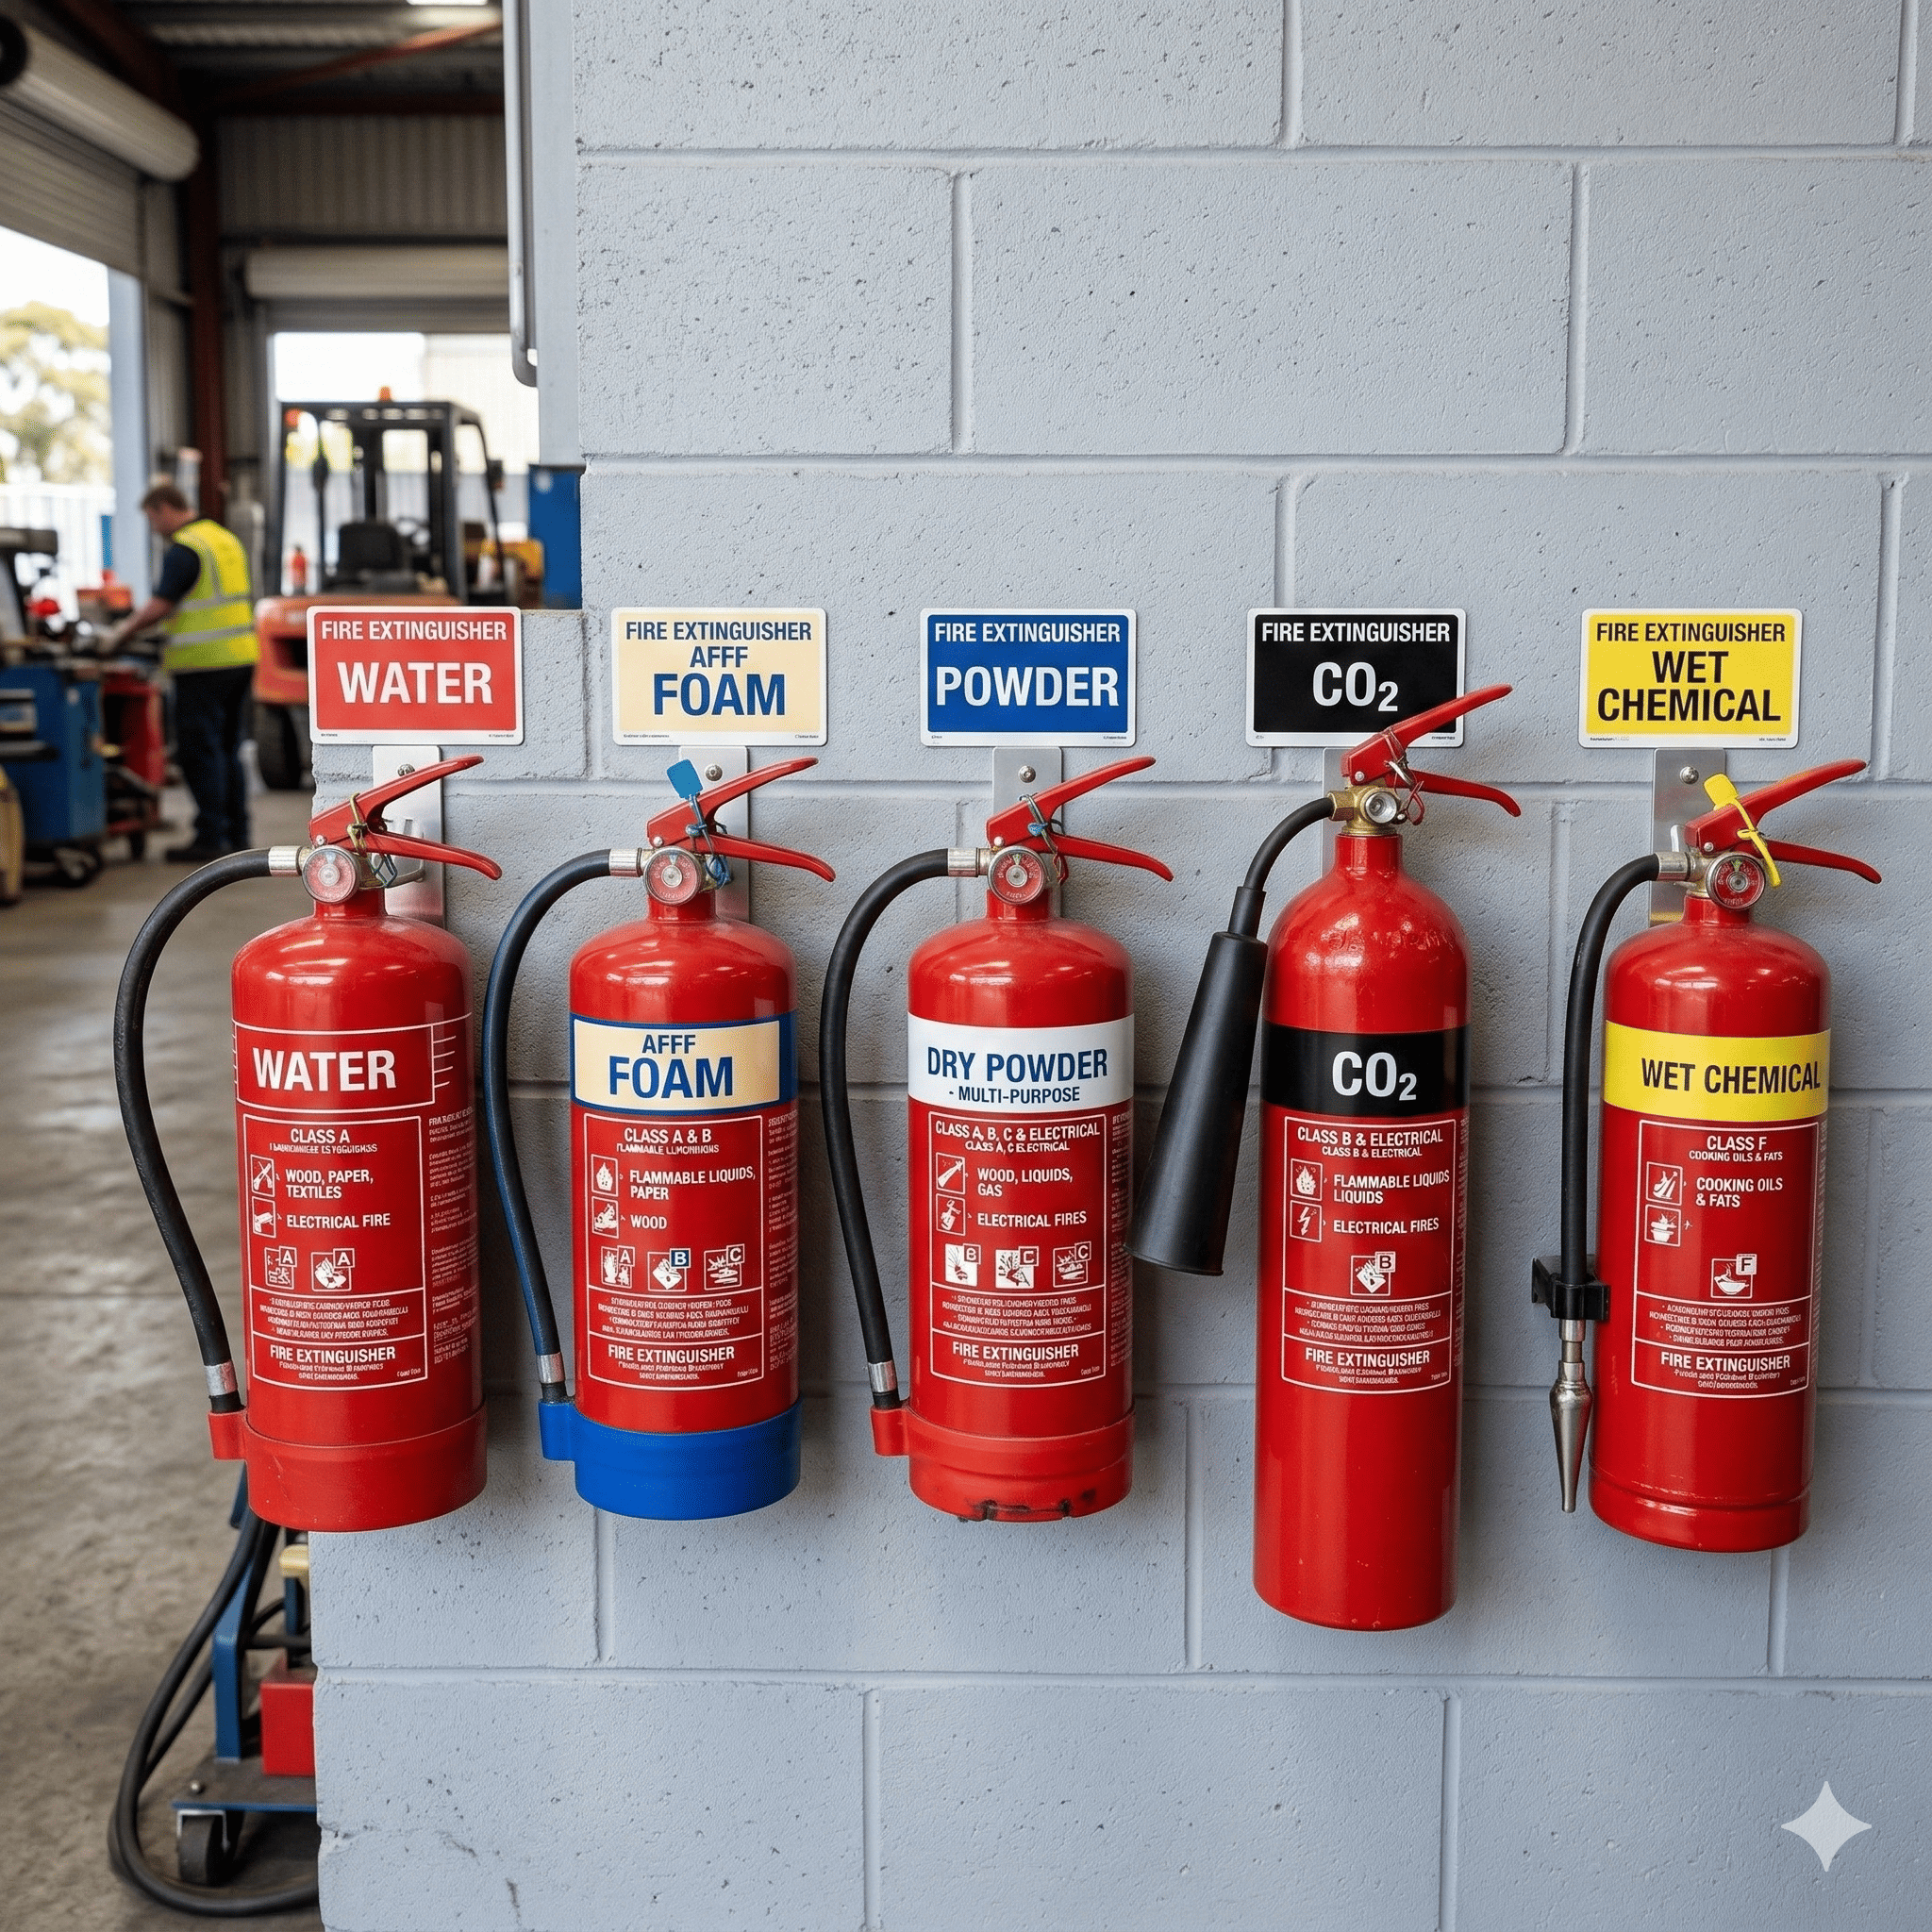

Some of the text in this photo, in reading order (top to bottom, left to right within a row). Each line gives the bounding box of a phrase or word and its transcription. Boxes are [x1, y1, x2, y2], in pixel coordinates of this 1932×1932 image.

[322, 621, 507, 641] FIRE EXTINGUISHER
[626, 622, 812, 641] FIRE EXTINGUISHER
[935, 624, 1121, 642] FIRE EXTINGUISHER
[1262, 623, 1450, 642] FIRE EXTINGUISHER
[1597, 624, 1785, 641] FIRE EXTINGUISHER
[690, 647, 748, 668] AFFF
[1653, 651, 1728, 683] WET
[337, 662, 492, 704] WATER
[935, 666, 1119, 707] POWDER
[654, 674, 786, 716] FOAM
[1598, 689, 1781, 721] CHEMICAL
[642, 1035, 695, 1054] AFFF
[253, 1048, 396, 1091] WATER
[928, 1047, 1108, 1082] DRY POWDER
[609, 1056, 733, 1099] FOAM
[1641, 1058, 1820, 1094] WET CHEMICAL
[958, 1086, 1080, 1104] MULTI-PURPOSE
[291, 1128, 350, 1143] CLASS A
[625, 1128, 711, 1143] CLASS A & B
[936, 1121, 970, 1138] CLASS
[1004, 1128, 1012, 1141] C
[1017, 1128, 1025, 1141] &
[1030, 1123, 1100, 1141] ELECTRICAL
[1298, 1126, 1442, 1146] CLASS B & ELECTRICAL
[1322, 1146, 1422, 1158] CLASS B & ELECTRICAL
[1707, 1136, 1767, 1151] CLASS F
[1689, 1151, 1783, 1161] COOKING OILS & FATS
[286, 1169, 374, 1185] WOOD, PAPER,
[630, 1166, 756, 1185] FLAMMABLE LIQUIDS,
[977, 1168, 1073, 1184] WOOD, LIQUIDS,
[1334, 1170, 1450, 1189] FLAMMABLE LIQUIDS
[1696, 1177, 1783, 1191] COOKING OILS
[286, 1185, 341, 1199] TEXTILES
[630, 1186, 669, 1200] PAPER
[977, 1185, 1003, 1197] GAS
[1334, 1190, 1383, 1204] LIQUIDS
[1696, 1193, 1740, 1208] & FATS
[287, 1213, 391, 1229] ELECTRICAL FIRE
[631, 1215, 667, 1229] WOOD
[977, 1211, 1087, 1227] ELECTRICAL FIRES
[1334, 1218, 1439, 1234] ELECTRICAL FIRES
[283, 1251, 292, 1264] A
[337, 1253, 350, 1265] A
[620, 1250, 631, 1263] A
[675, 1253, 686, 1265] B
[729, 1248, 741, 1261] C
[966, 1248, 976, 1260] B
[1379, 1256, 1391, 1269] B
[1741, 1257, 1753, 1271] F
[270, 1345, 395, 1363] FIRE EXTINGUISHER
[608, 1344, 735, 1363] FIRE EXTINGUISHER
[953, 1341, 1079, 1361] FIRE EXTINGUISHER
[1306, 1347, 1430, 1367] FIRE EXTINGUISHER
[1661, 1352, 1790, 1372] FIRE EXTINGUISHER
